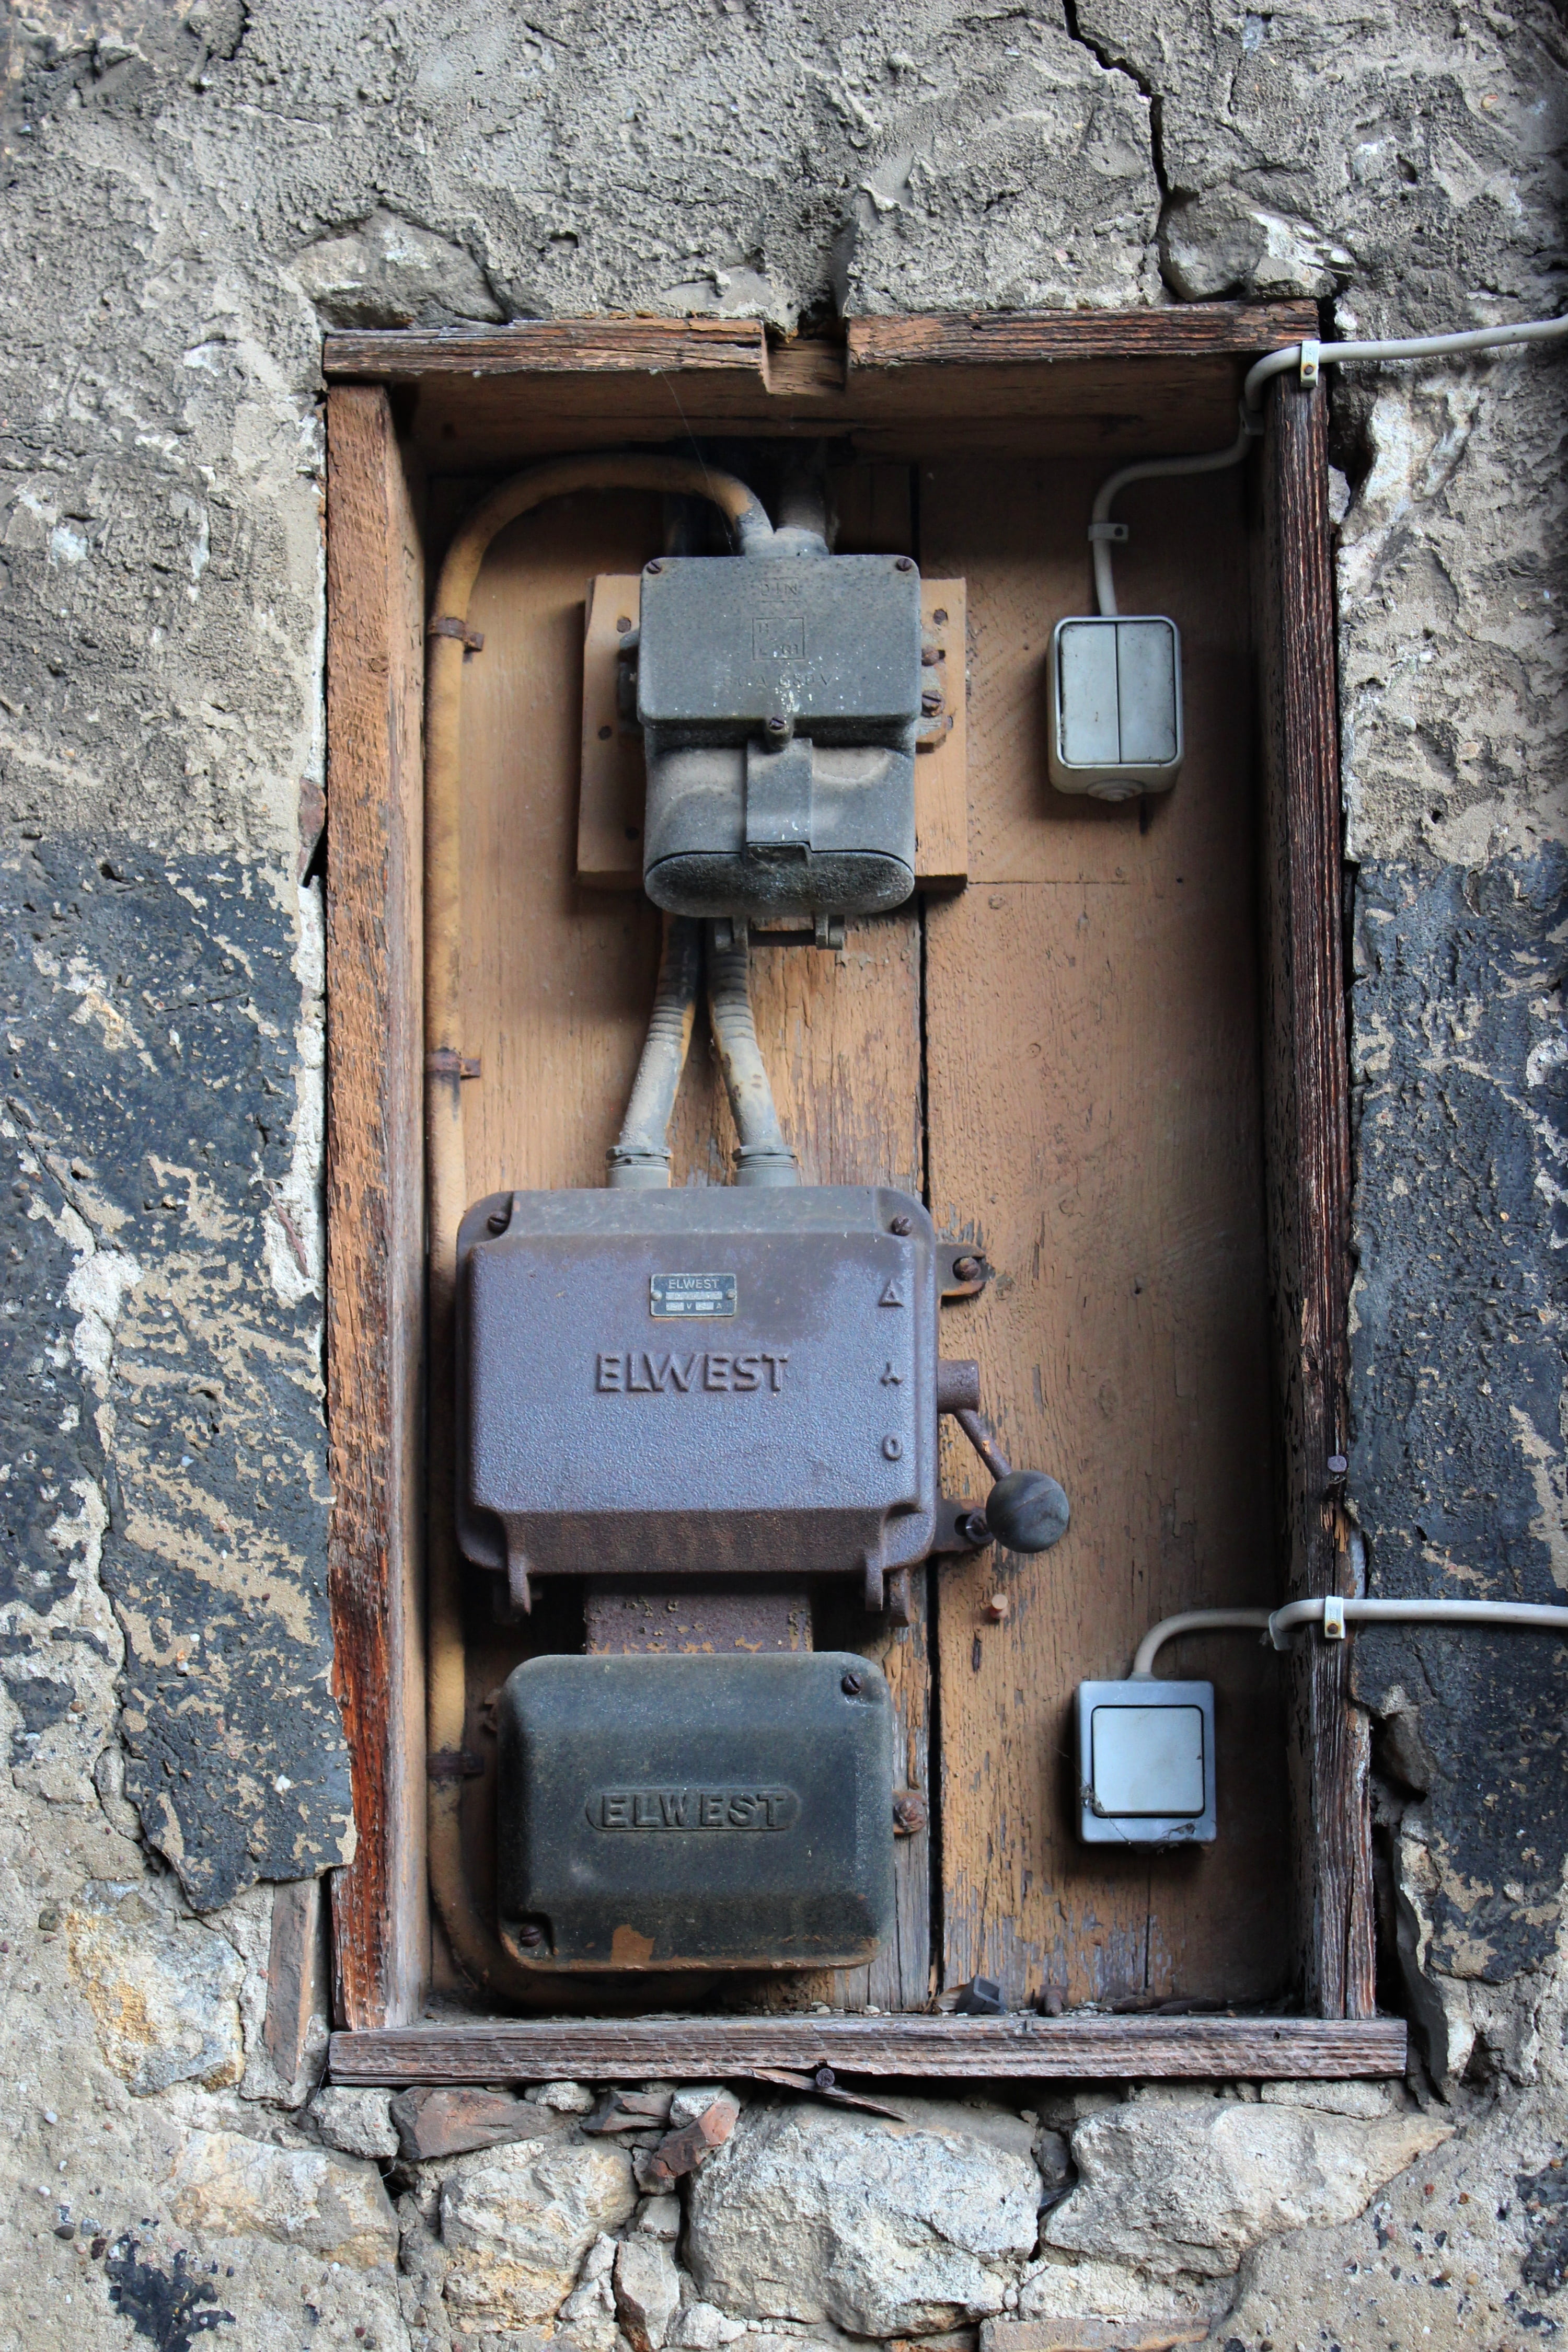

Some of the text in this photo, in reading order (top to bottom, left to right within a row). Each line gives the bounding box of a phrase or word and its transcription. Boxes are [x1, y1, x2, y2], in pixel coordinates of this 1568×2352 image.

[668, 1279, 719, 1289] ELWEST
[597, 1352, 789, 1392] ELWEST
[601, 1791, 785, 1827] ELWEST
